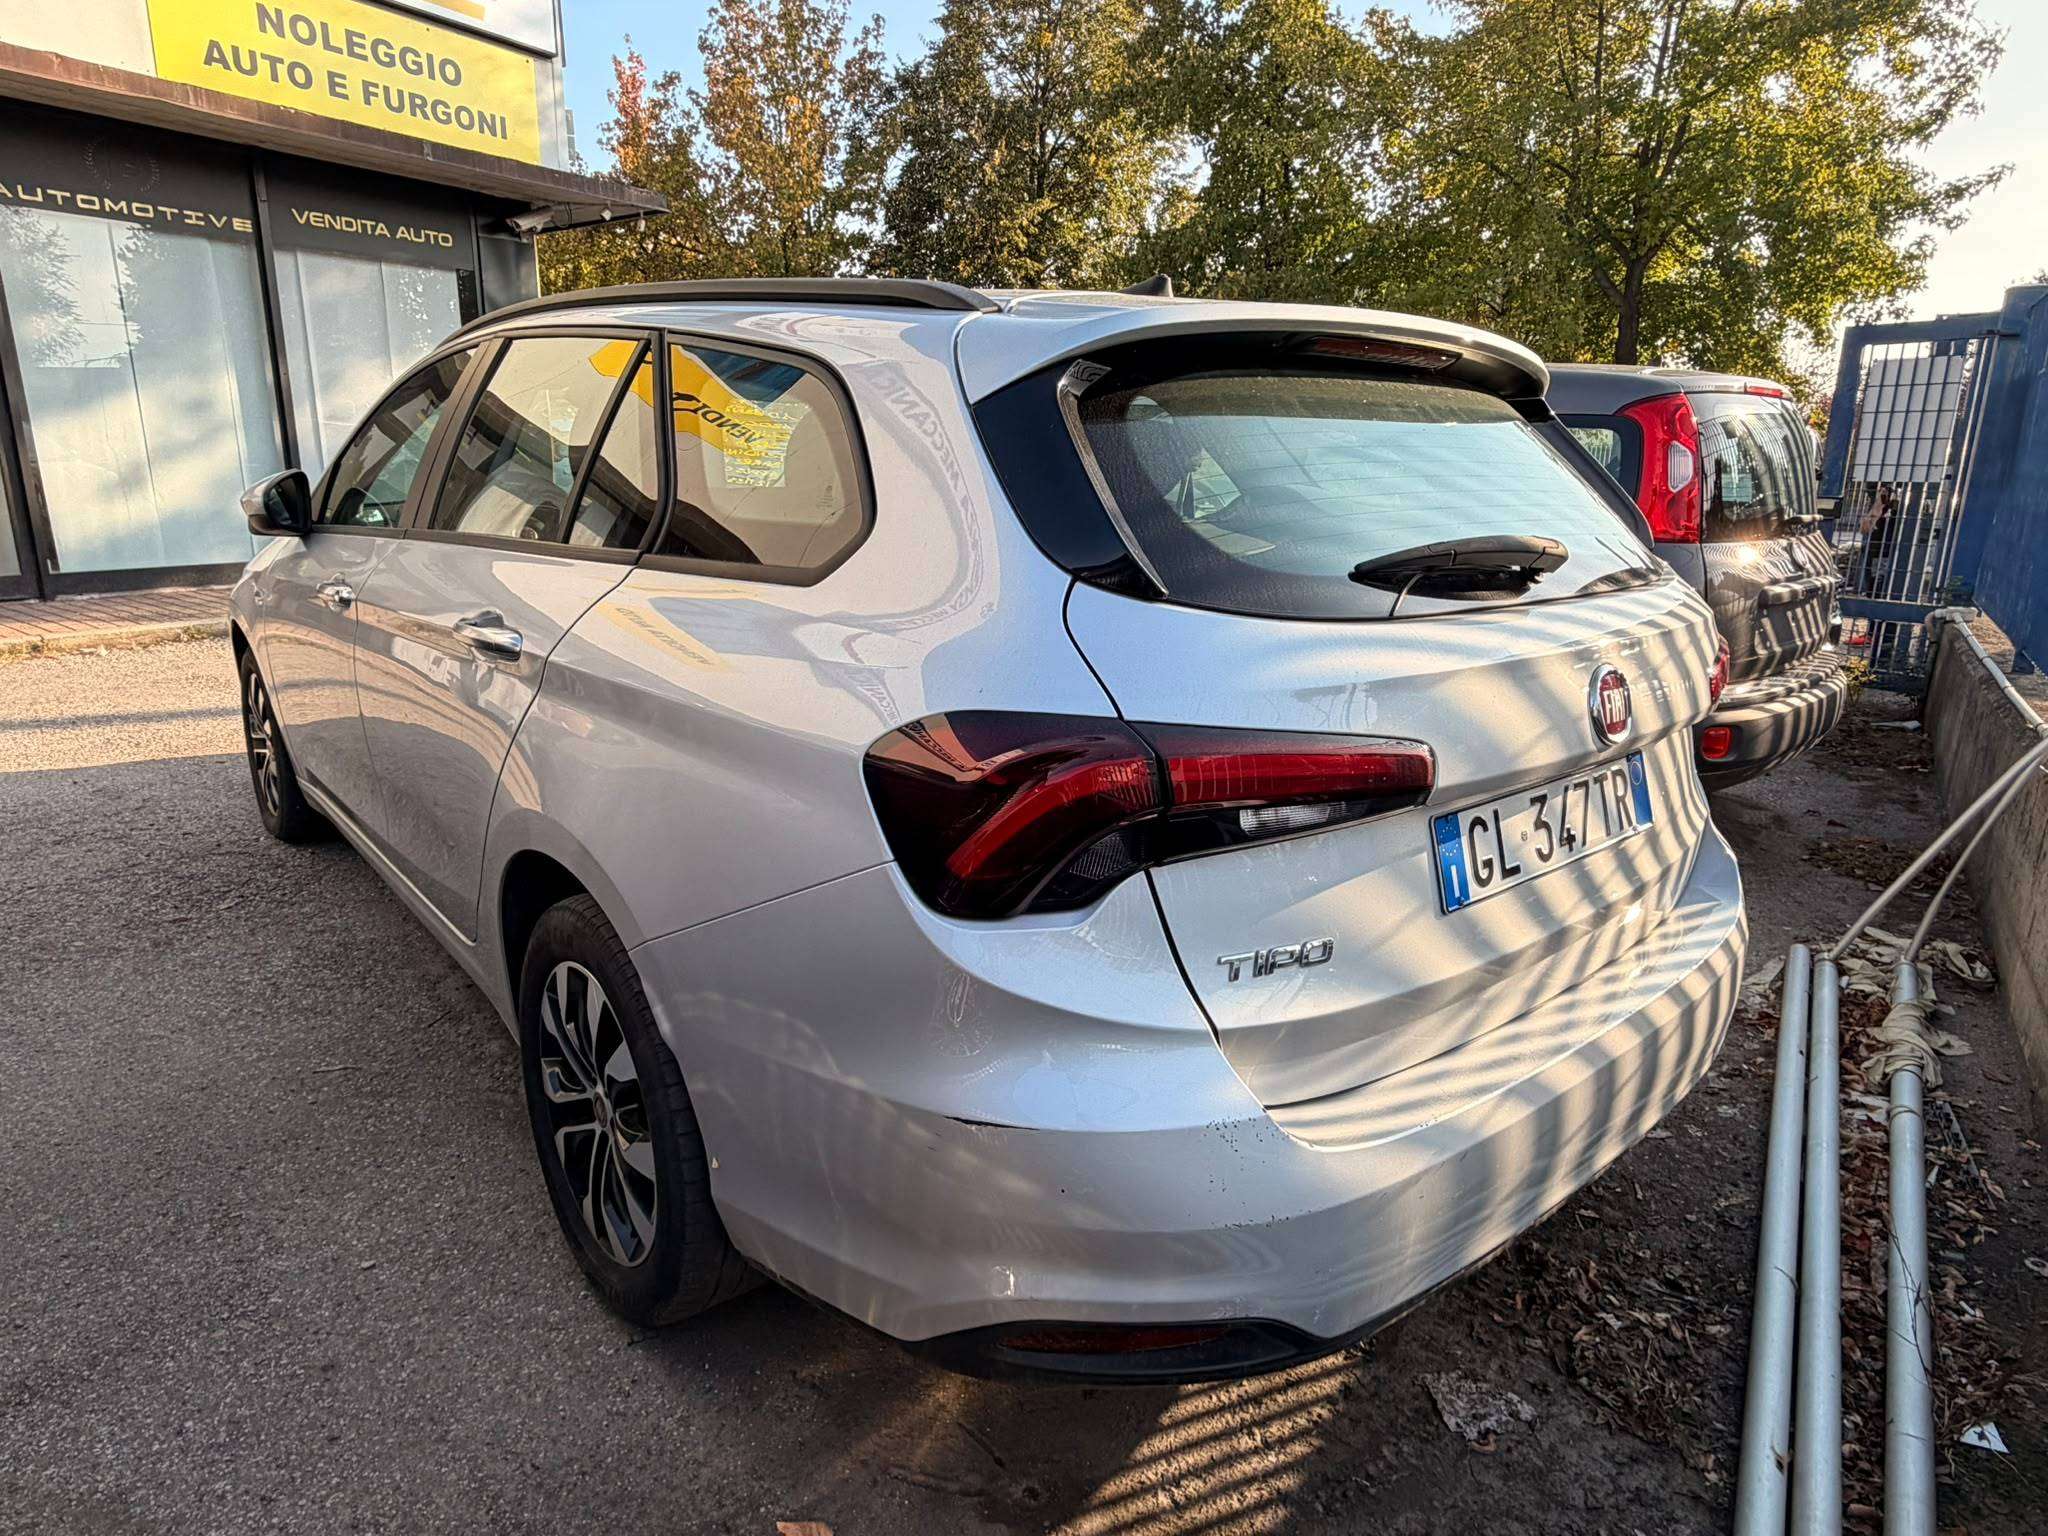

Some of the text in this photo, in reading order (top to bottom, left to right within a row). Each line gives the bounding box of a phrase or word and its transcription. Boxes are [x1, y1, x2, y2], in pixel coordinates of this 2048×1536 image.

[256, 2, 463, 88] NOLEGGIO
[203, 39, 508, 140] AUTO E FURGONI
[291, 208, 453, 248] VENDITA AUTO
[1603, 687, 1626, 724] FIAT
[1217, 936, 1335, 982] TIPO
